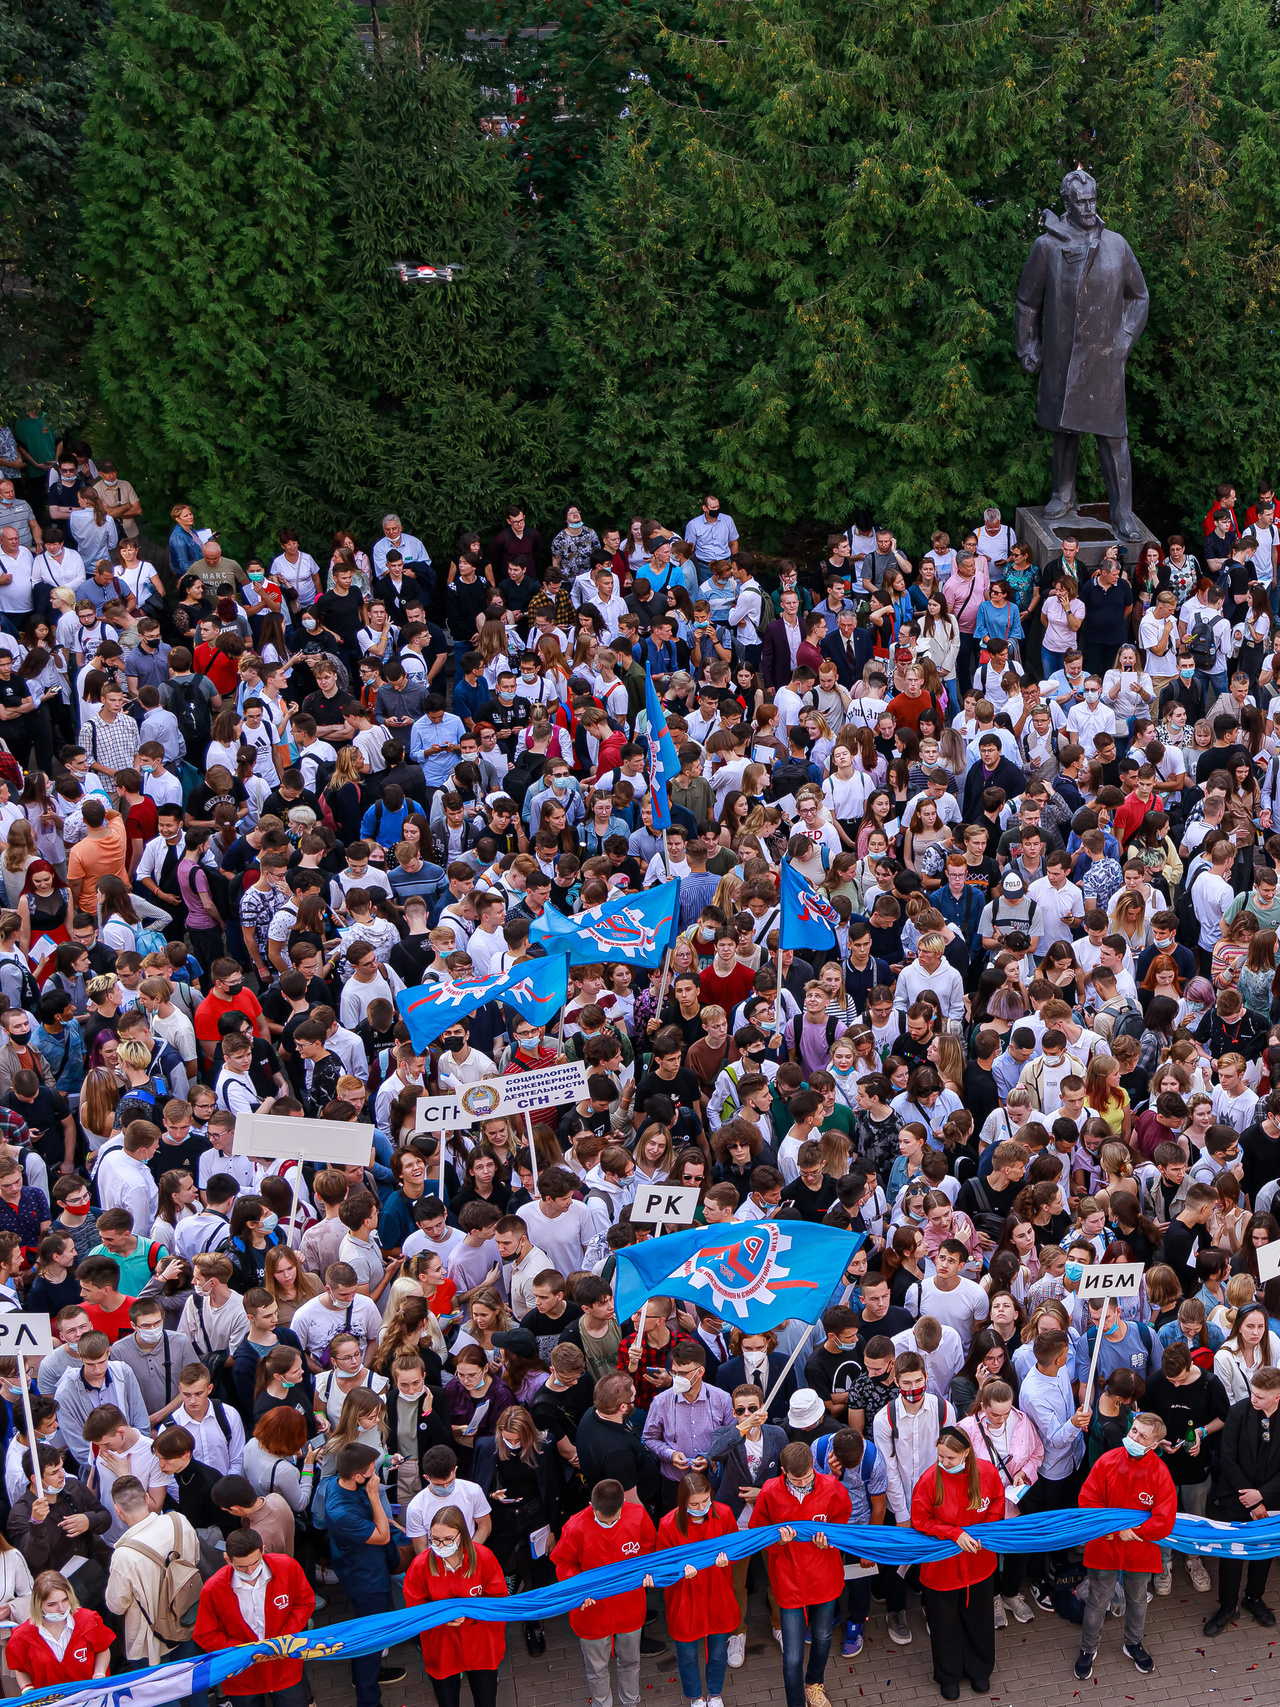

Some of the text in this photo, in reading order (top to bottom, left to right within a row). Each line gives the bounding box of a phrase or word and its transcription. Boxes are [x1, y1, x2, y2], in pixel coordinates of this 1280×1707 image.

[202, 572, 227, 580] MARC
[505, 1073, 581, 1093] ИНЖЕНЕРНОЙ
[506, 1066, 577, 1085] СОЦИОЛОГИЯ
[503, 1080, 585, 1102] ДЕЯТЕЛЬНОСТИ
[517, 1095, 550, 1109] СГН
[564, 1090, 574, 1099] 2
[645, 1194, 684, 1215] РК
[1085, 1273, 1134, 1289] ИБМ
